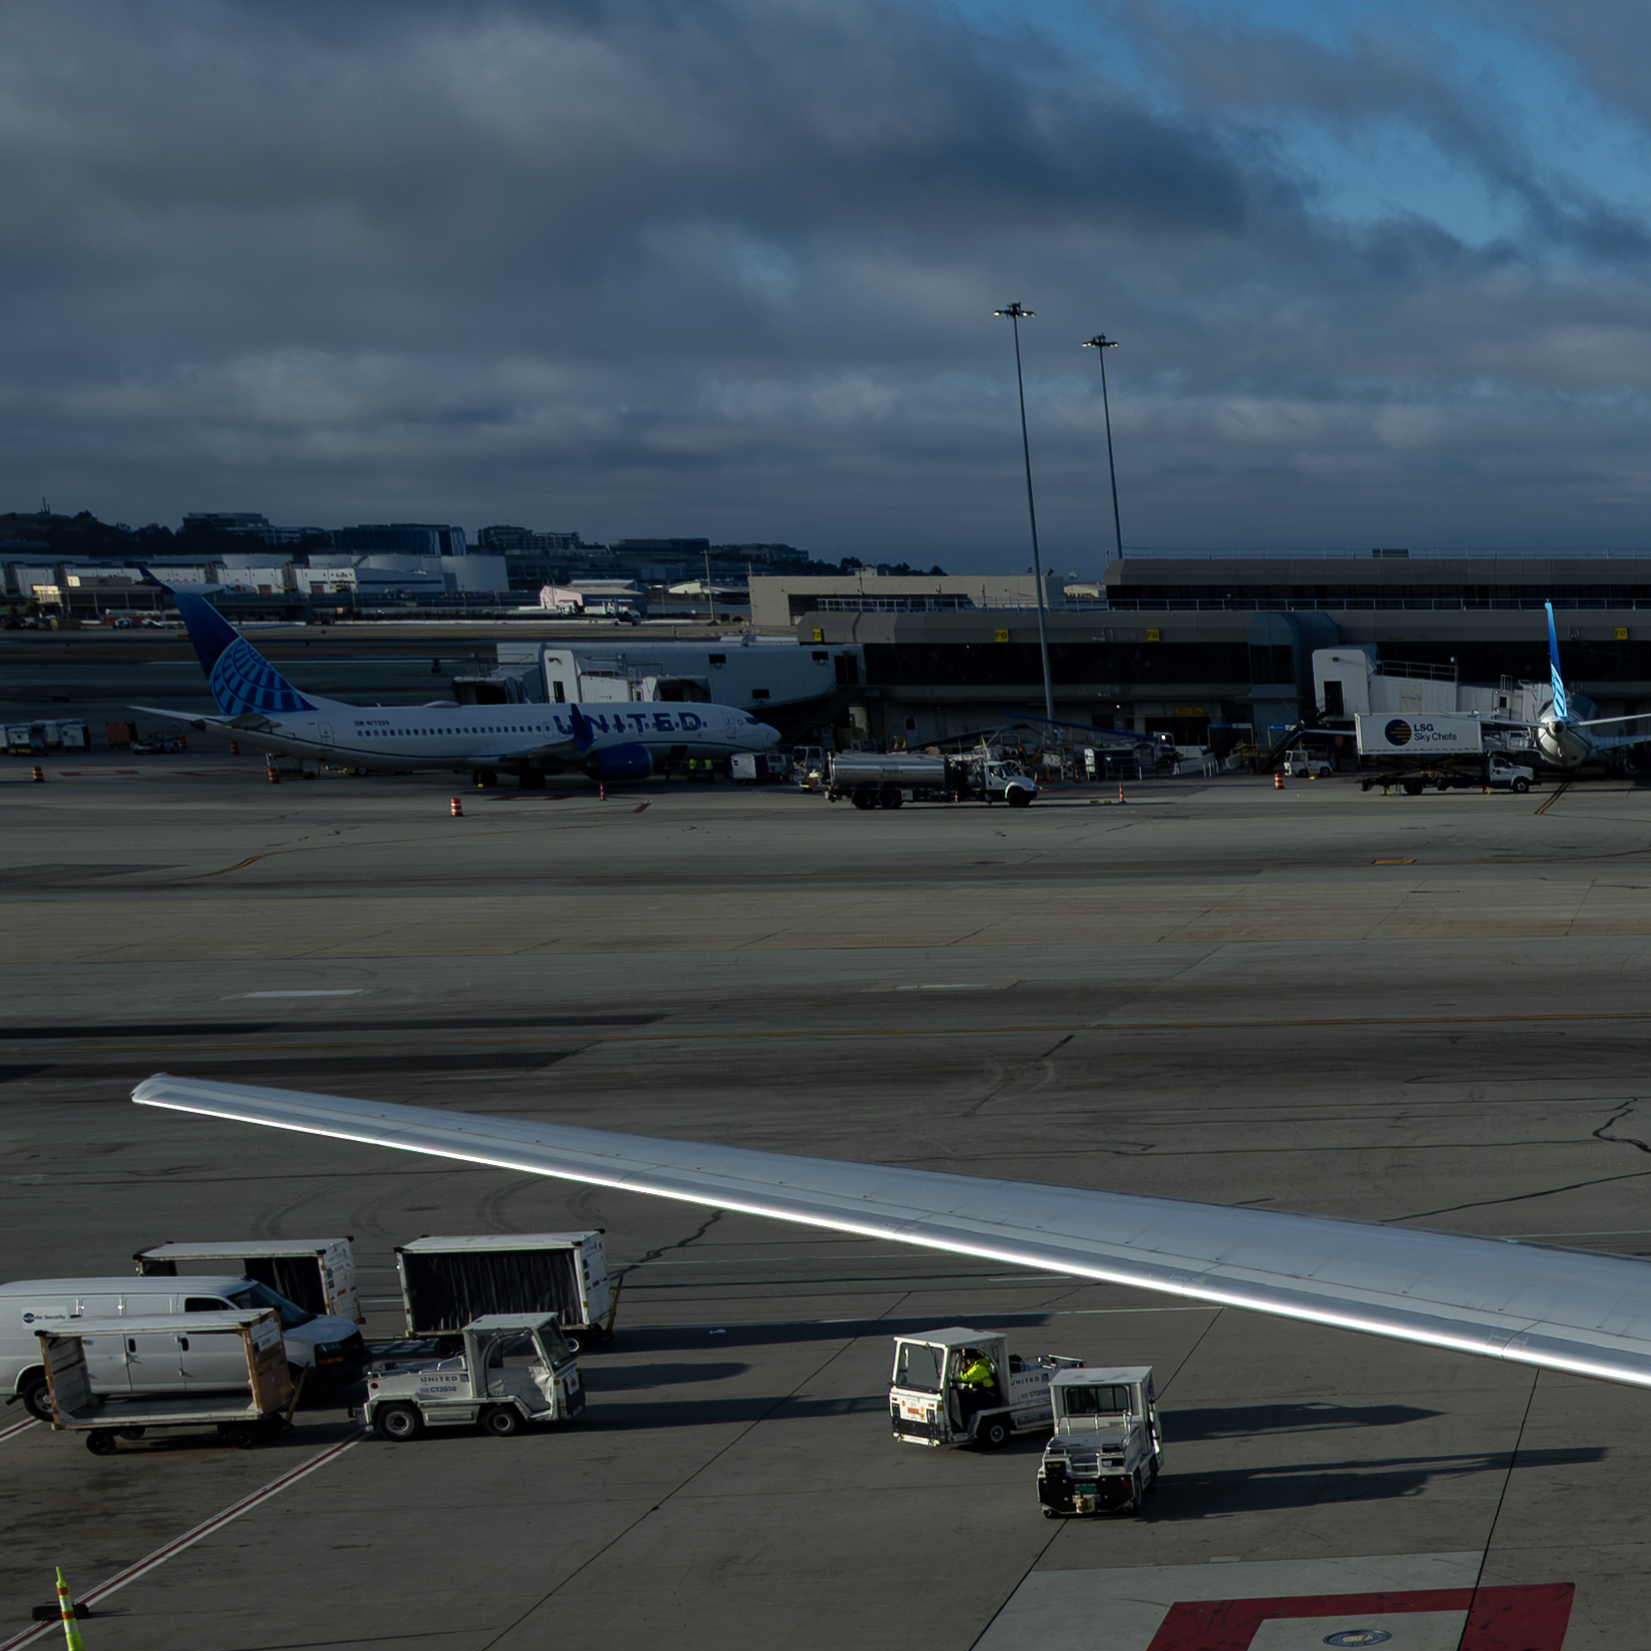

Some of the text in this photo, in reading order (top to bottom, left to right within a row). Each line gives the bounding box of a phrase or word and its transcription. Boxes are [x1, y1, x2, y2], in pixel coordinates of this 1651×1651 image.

[552, 711, 703, 735] UNITED
[1413, 723, 1434, 732] LSG
[1414, 732, 1457, 742] Sky Chefs
[420, 1375, 458, 1383] UNITED
[1010, 1375, 1040, 1386] UNITED
